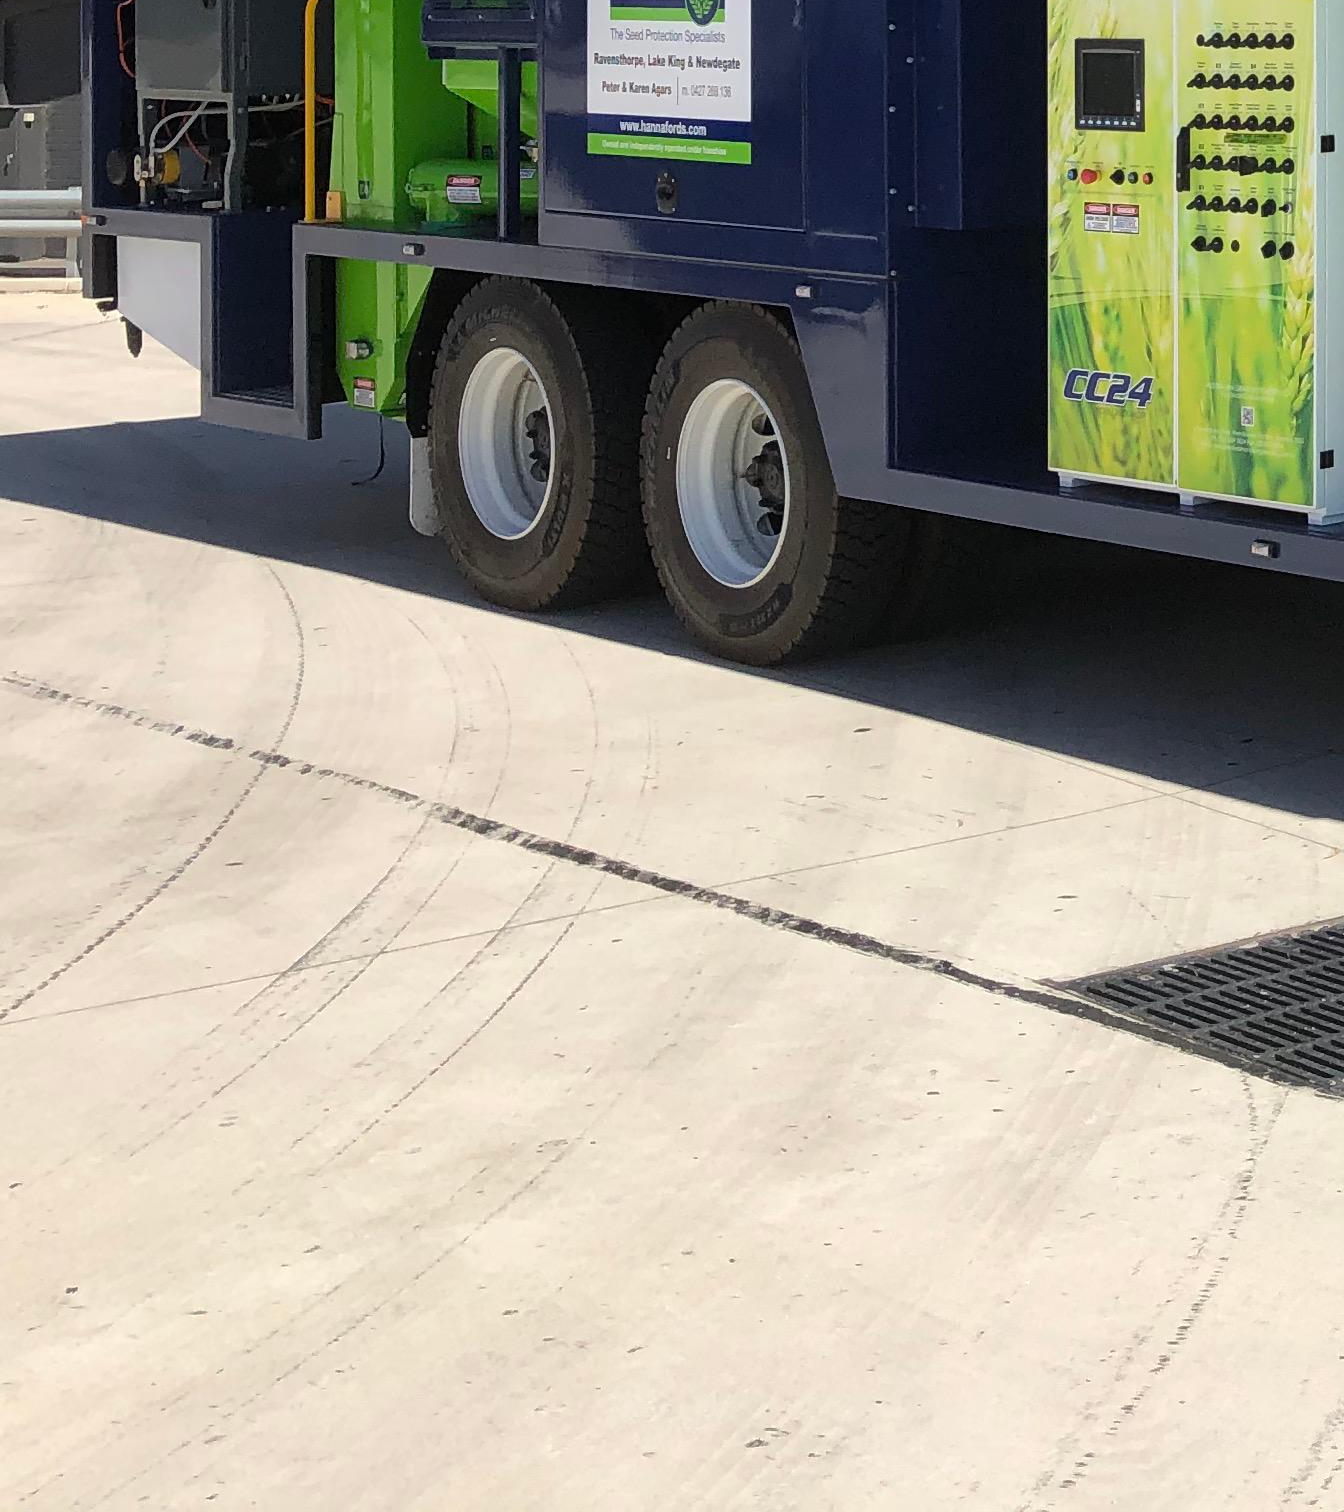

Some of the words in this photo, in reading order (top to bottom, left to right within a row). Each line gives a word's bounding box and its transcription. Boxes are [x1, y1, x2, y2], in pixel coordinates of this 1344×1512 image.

[610, 28, 624, 40] The
[625, 28, 644, 41] Seed
[646, 29, 683, 42] Protection
[685, 30, 725, 44] Specialists
[594, 53, 646, 68] Ravensthorpe,
[648, 55, 665, 67] Lake
[668, 55, 685, 70] King
[688, 56, 694, 68] &
[696, 56, 741, 71] Newdegate
[602, 81, 620, 92] Peter
[622, 82, 627, 92] &
[629, 82, 649, 93] Karen
[620, 120, 707, 136] www.hannafords.com
[1063, 368, 1155, 408] CC24
